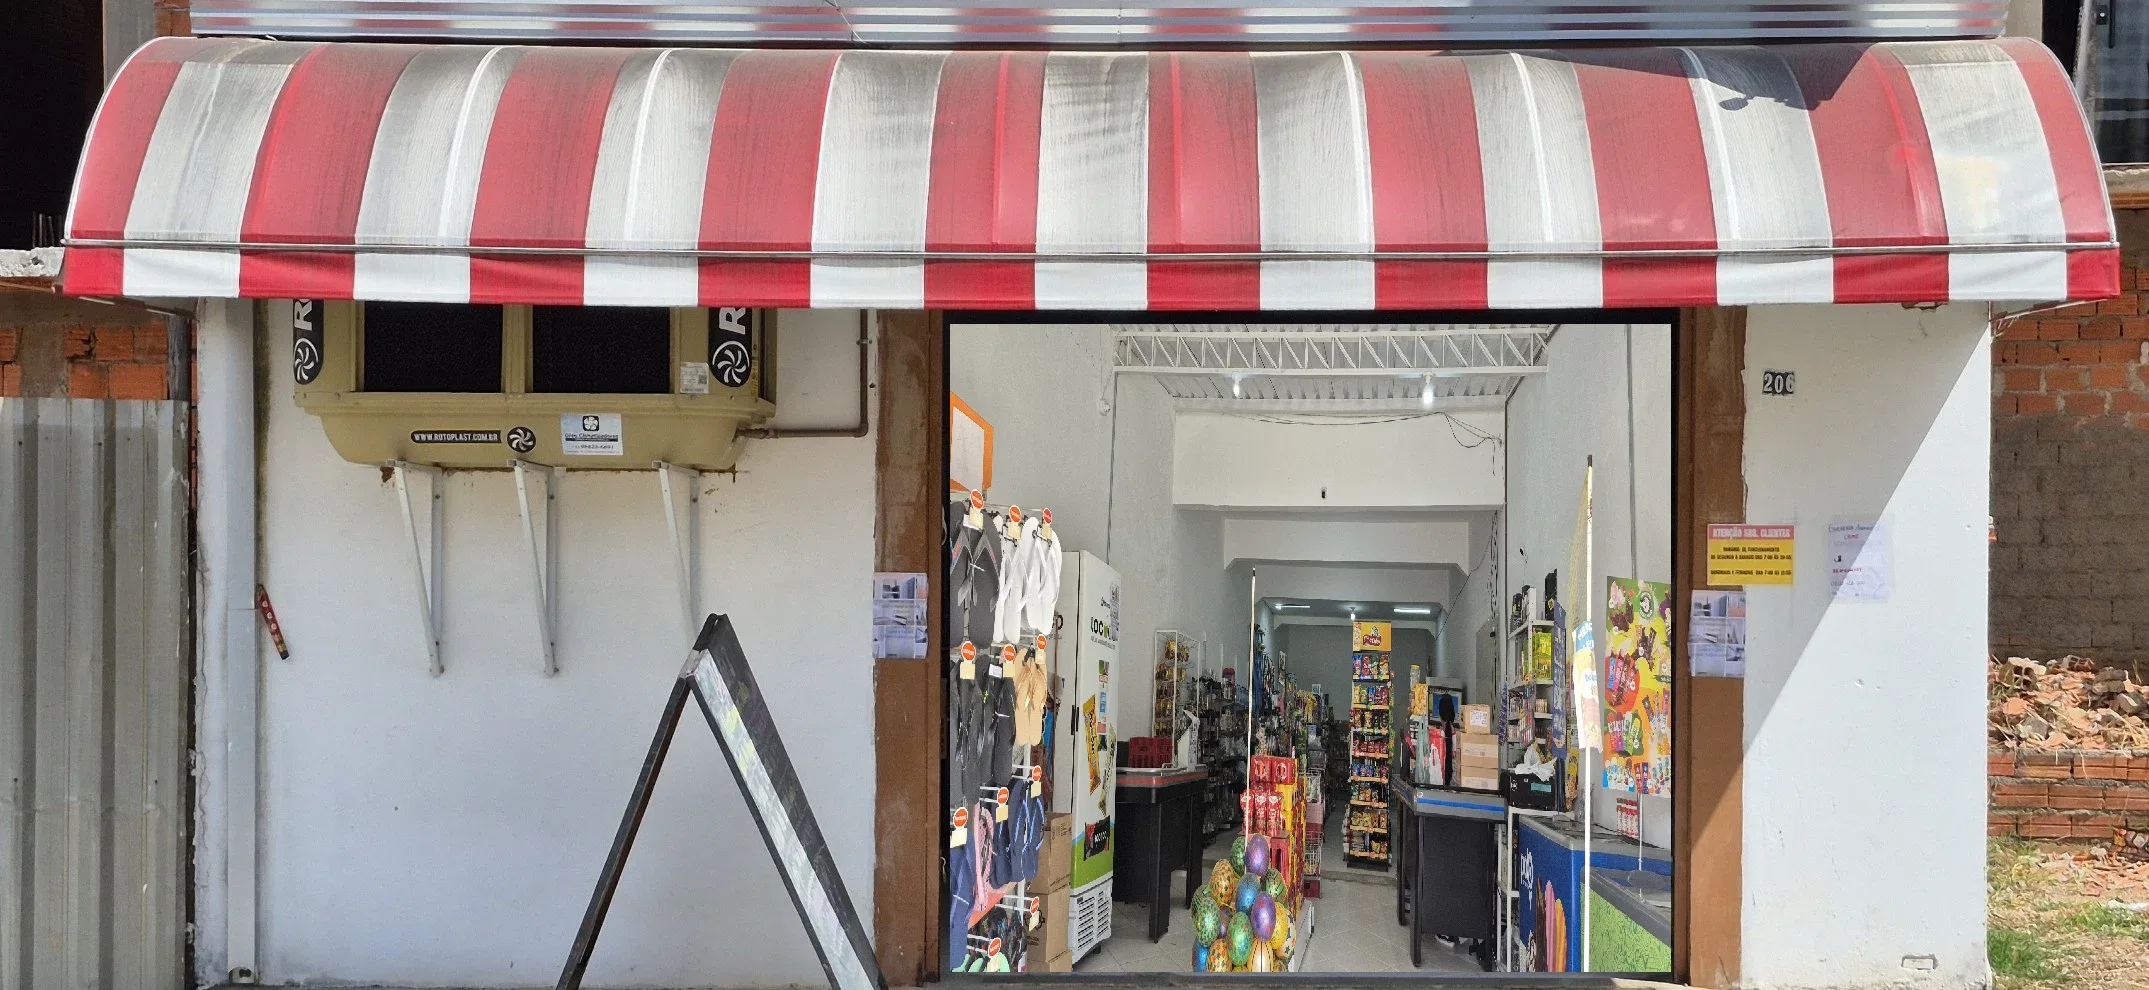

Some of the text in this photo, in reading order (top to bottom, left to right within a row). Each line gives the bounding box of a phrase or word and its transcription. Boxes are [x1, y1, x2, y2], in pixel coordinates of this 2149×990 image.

[1763, 373, 1795, 394] 206
[413, 433, 499, 442] WWW.ROTOPLAST.COM.BR
[1760, 528, 1791, 538] CLIENTES
